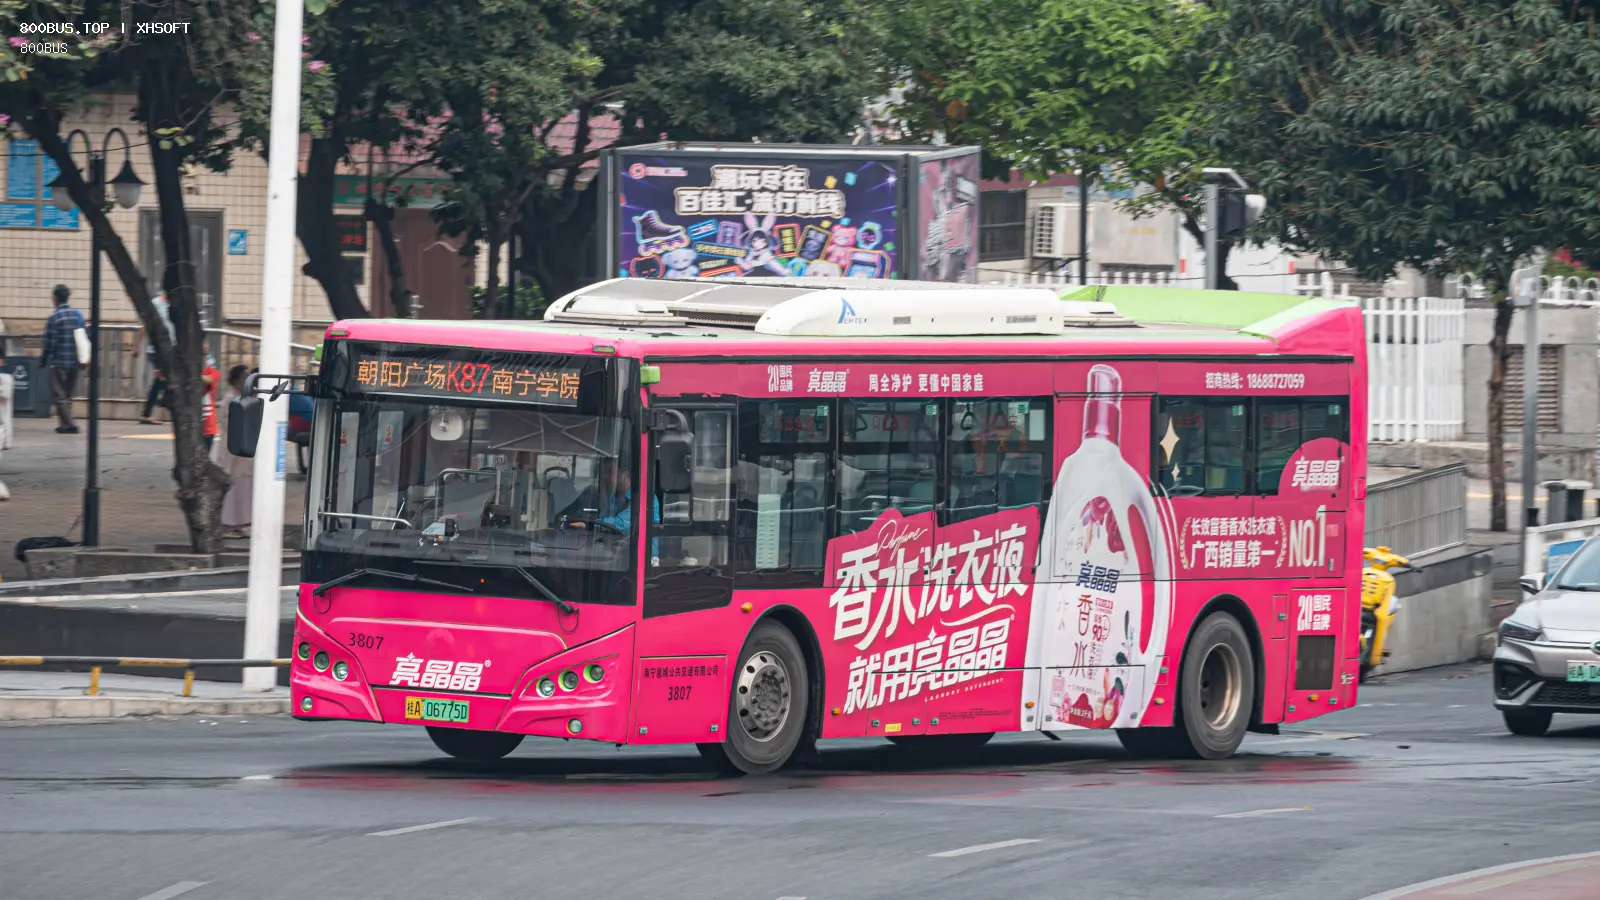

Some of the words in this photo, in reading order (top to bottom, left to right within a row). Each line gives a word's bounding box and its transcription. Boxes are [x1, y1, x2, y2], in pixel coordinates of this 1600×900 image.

[356, 359, 446, 390] 朝阳广场
[446, 361, 492, 394] K87
[492, 368, 581, 399] 南宁学院
[807, 367, 848, 393] 亮晶晶
[868, 373, 913, 393] 周全净护
[917, 372, 985, 393] 更懂中国家庭
[1246, 373, 1306, 389] 18688727059
[1291, 456, 1341, 487] 亮晶晶
[1190, 516, 1277, 537] 长效留香香水洗衣液
[1190, 539, 1276, 569] 广西销量第一
[829, 523, 1029, 651] 香水洗衣液
[1075, 560, 1120, 594] 亮晶晶
[1312, 594, 1332, 612] 国民
[348, 632, 384, 650] 3807
[389, 652, 484, 691] 亮晶晶
[843, 617, 1010, 715] 就用亮晶晶
[668, 686, 692, 701] 3807
